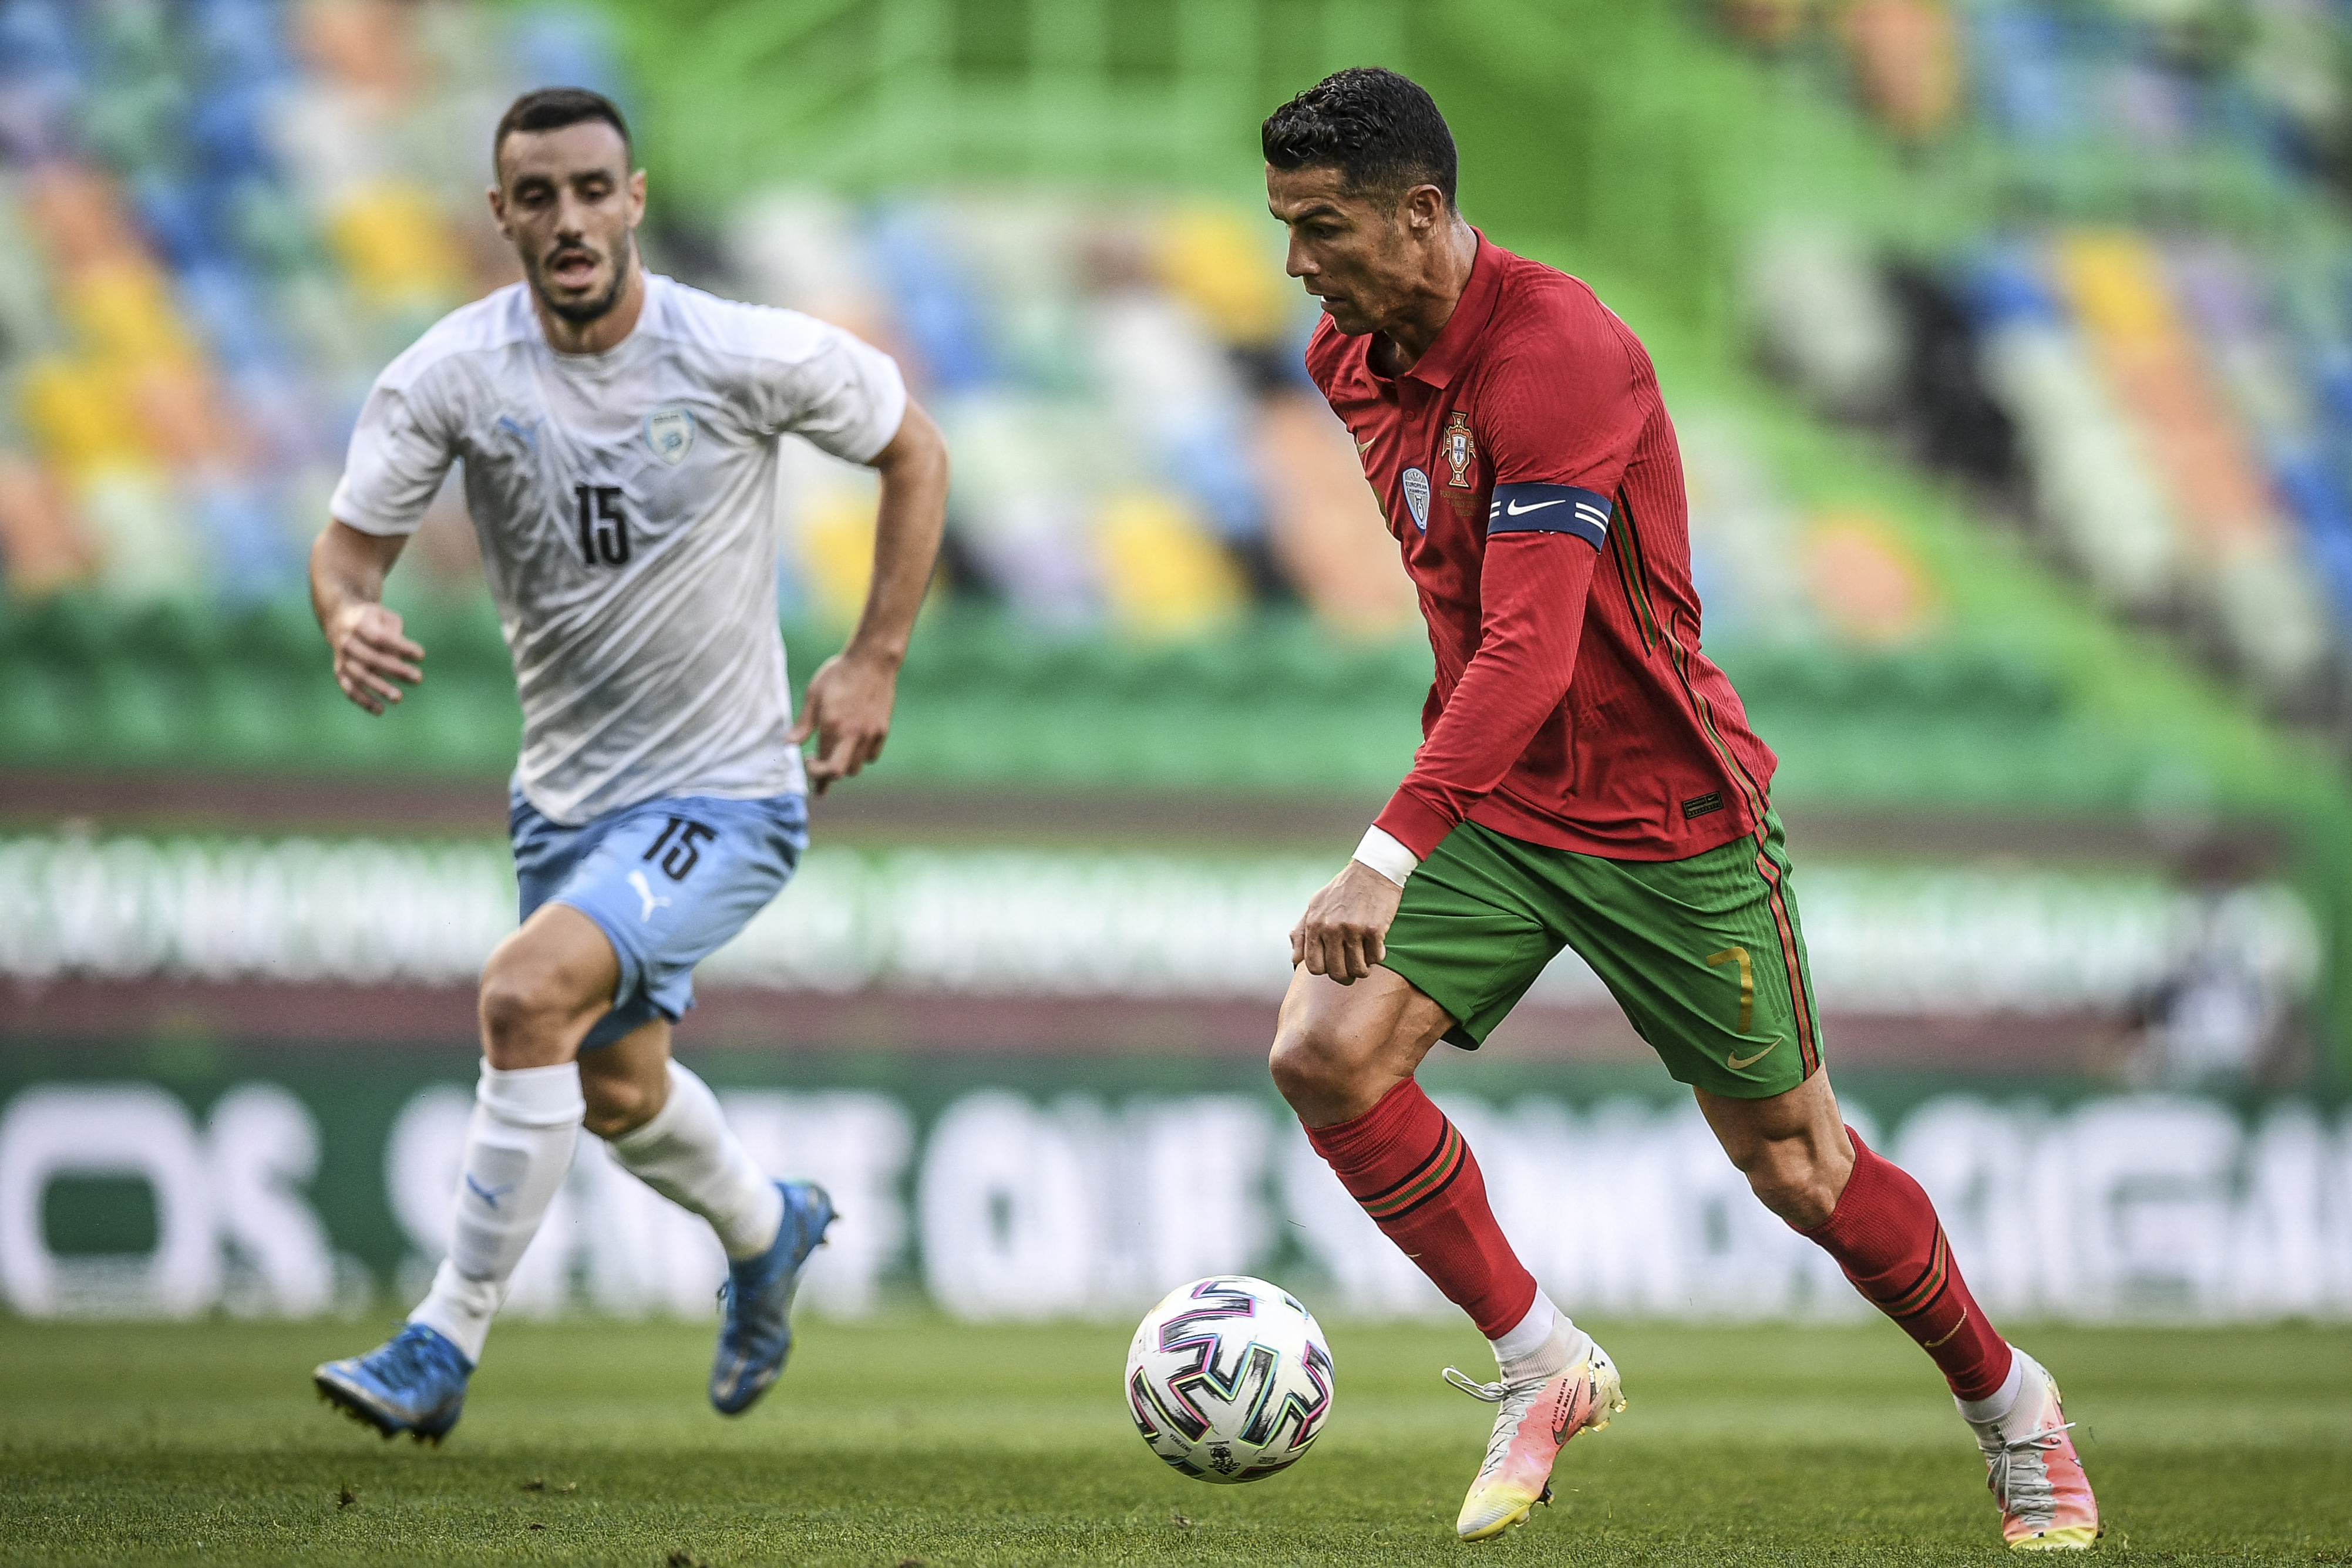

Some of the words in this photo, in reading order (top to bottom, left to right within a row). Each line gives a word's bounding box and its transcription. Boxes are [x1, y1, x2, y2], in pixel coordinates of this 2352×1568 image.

[1405, 481, 1427, 490] EUROPEAN
[1407, 487, 1428, 496] CHAMPIONS
[575, 486, 629, 564] 15
[644, 817, 718, 880] 15
[1706, 946, 1753, 1034] 7
[1551, 1406, 1560, 1425] ALANA
[1556, 1378, 1568, 1404] MARTINA
[1563, 1388, 1572, 1408] MARIA
[1169, 1433, 1192, 1453] UNIFORIA
